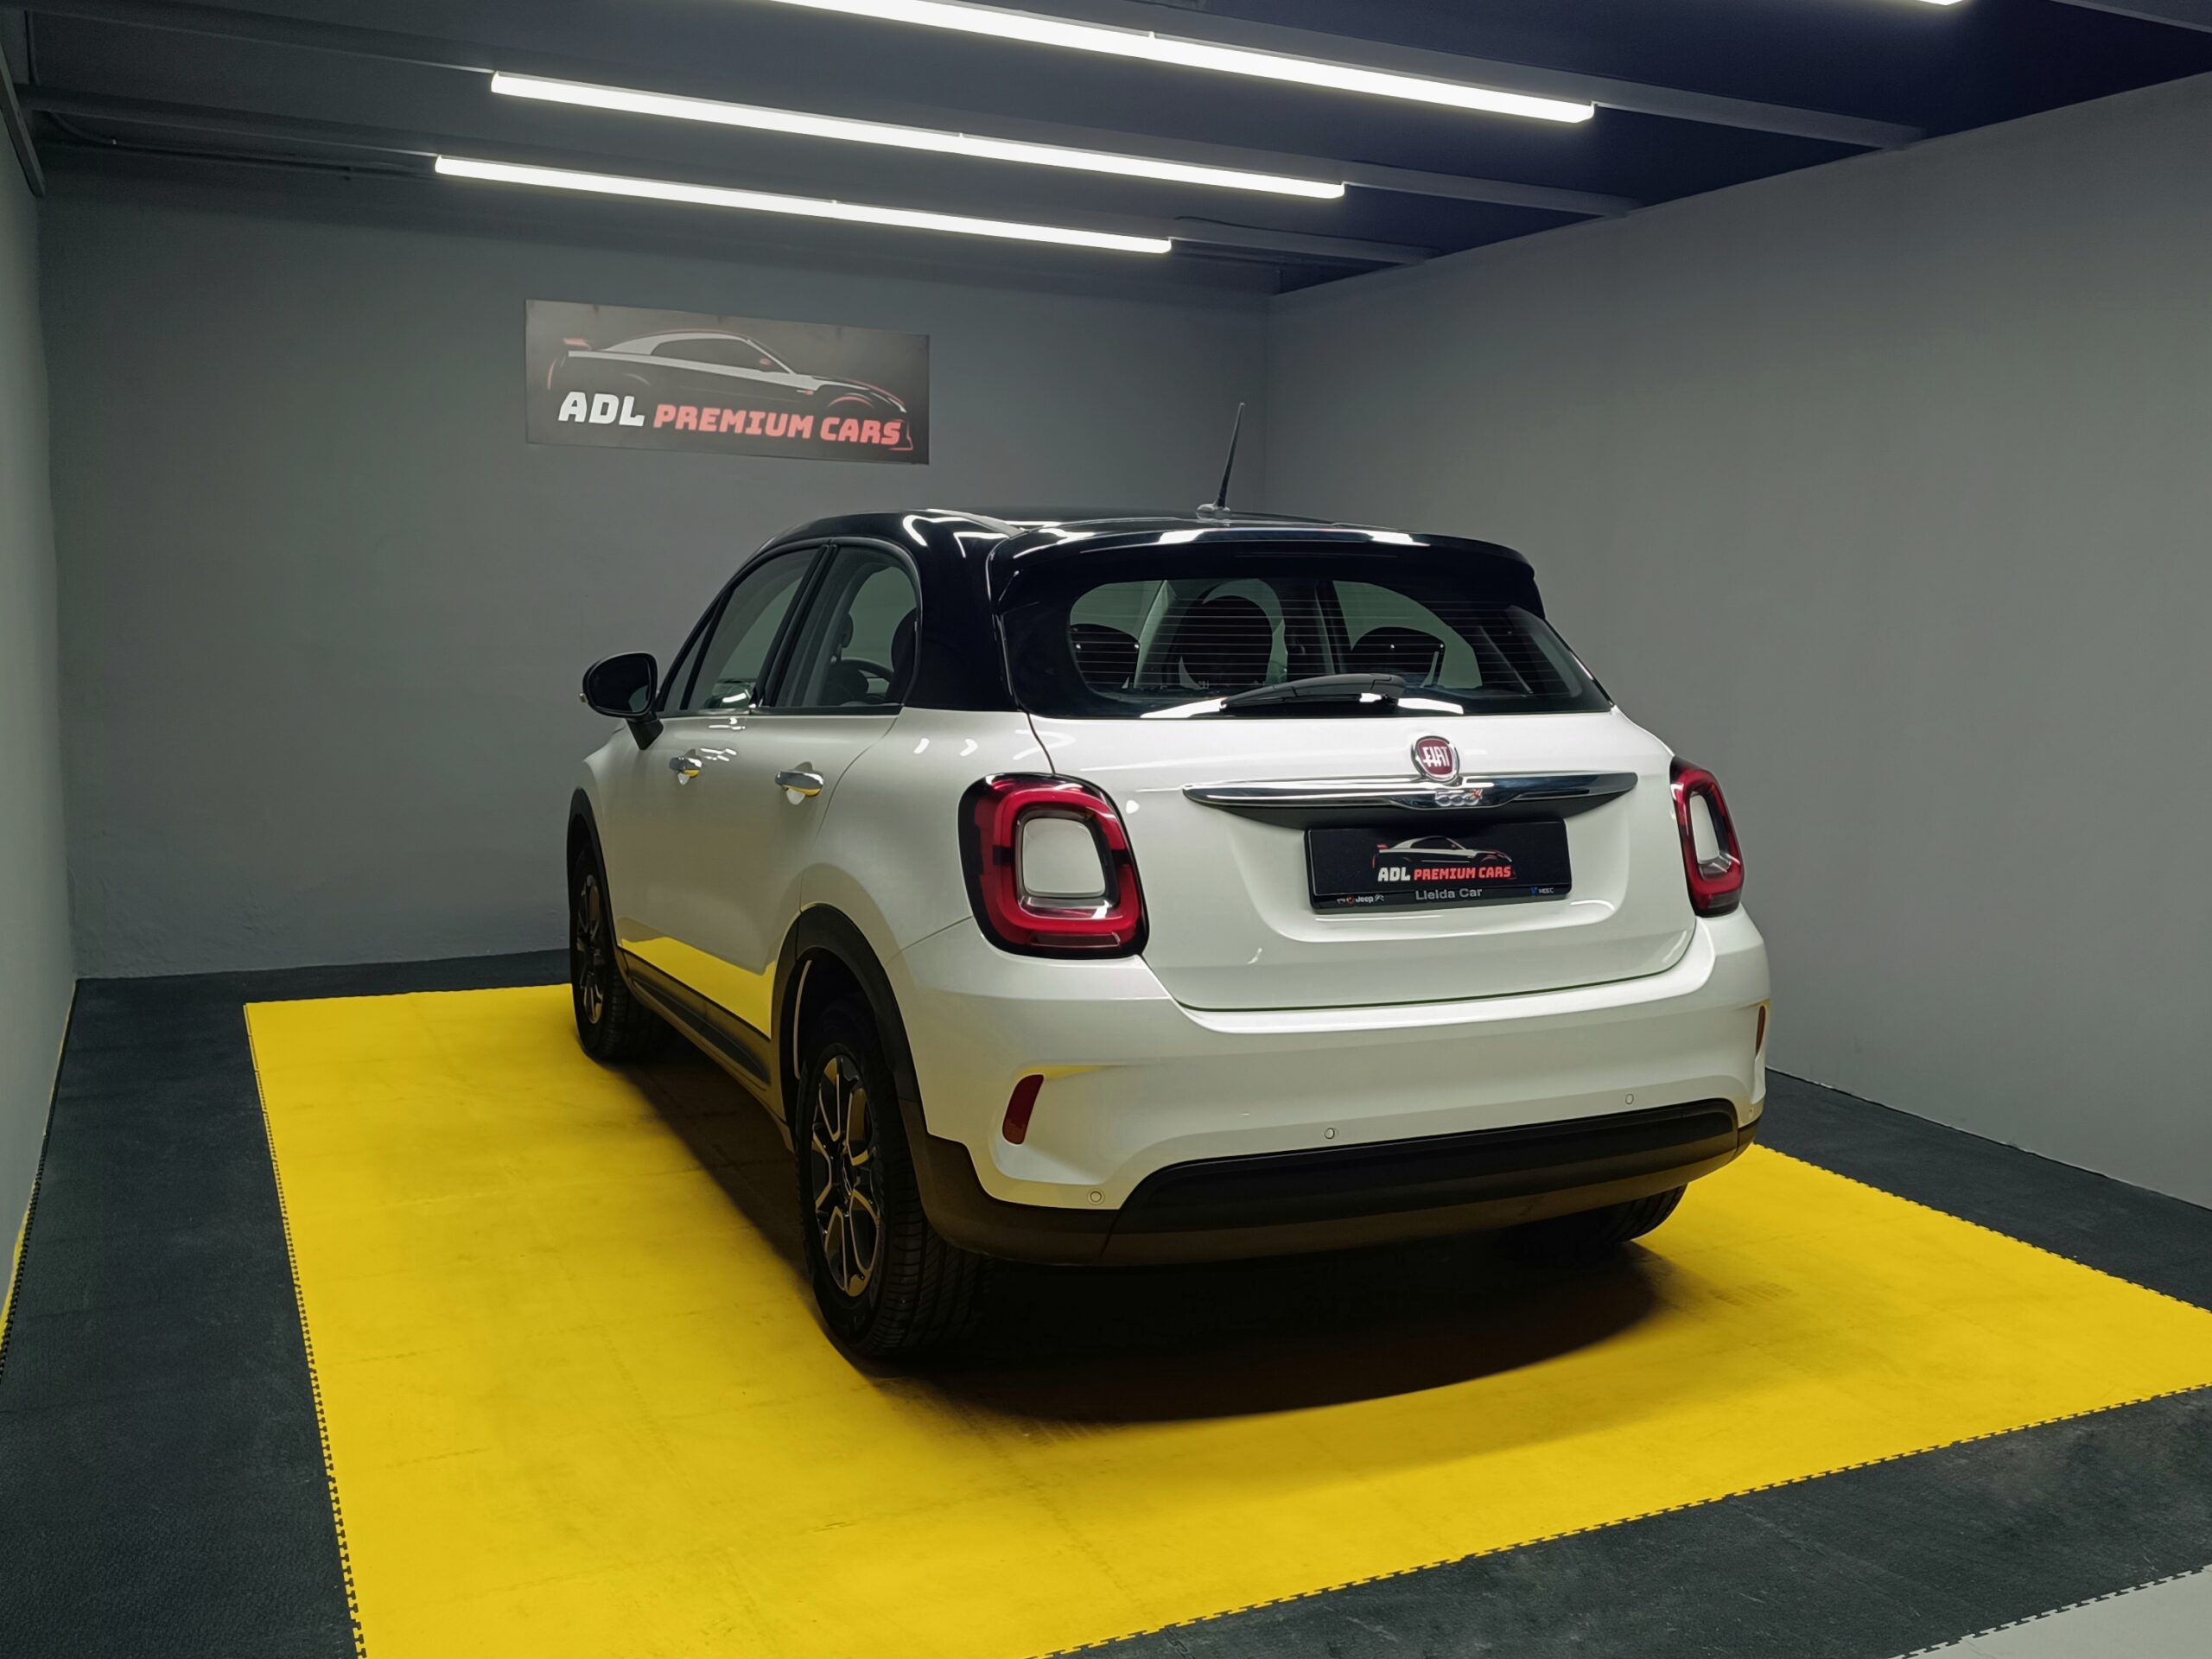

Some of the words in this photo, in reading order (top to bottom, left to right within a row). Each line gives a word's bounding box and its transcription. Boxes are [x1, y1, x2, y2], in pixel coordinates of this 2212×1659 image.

[558, 391, 645, 427] ADL
[654, 404, 814, 439] PREMIUM
[820, 417, 902, 446] CARS
[1422, 746, 1451, 767] FIAT
[1377, 867, 1411, 881] ADL
[1414, 867, 1476, 880] PREMIUM
[1478, 866, 1512, 878] CARS
[1355, 895, 1374, 904] Jeep
[1459, 887, 1483, 898] Car
